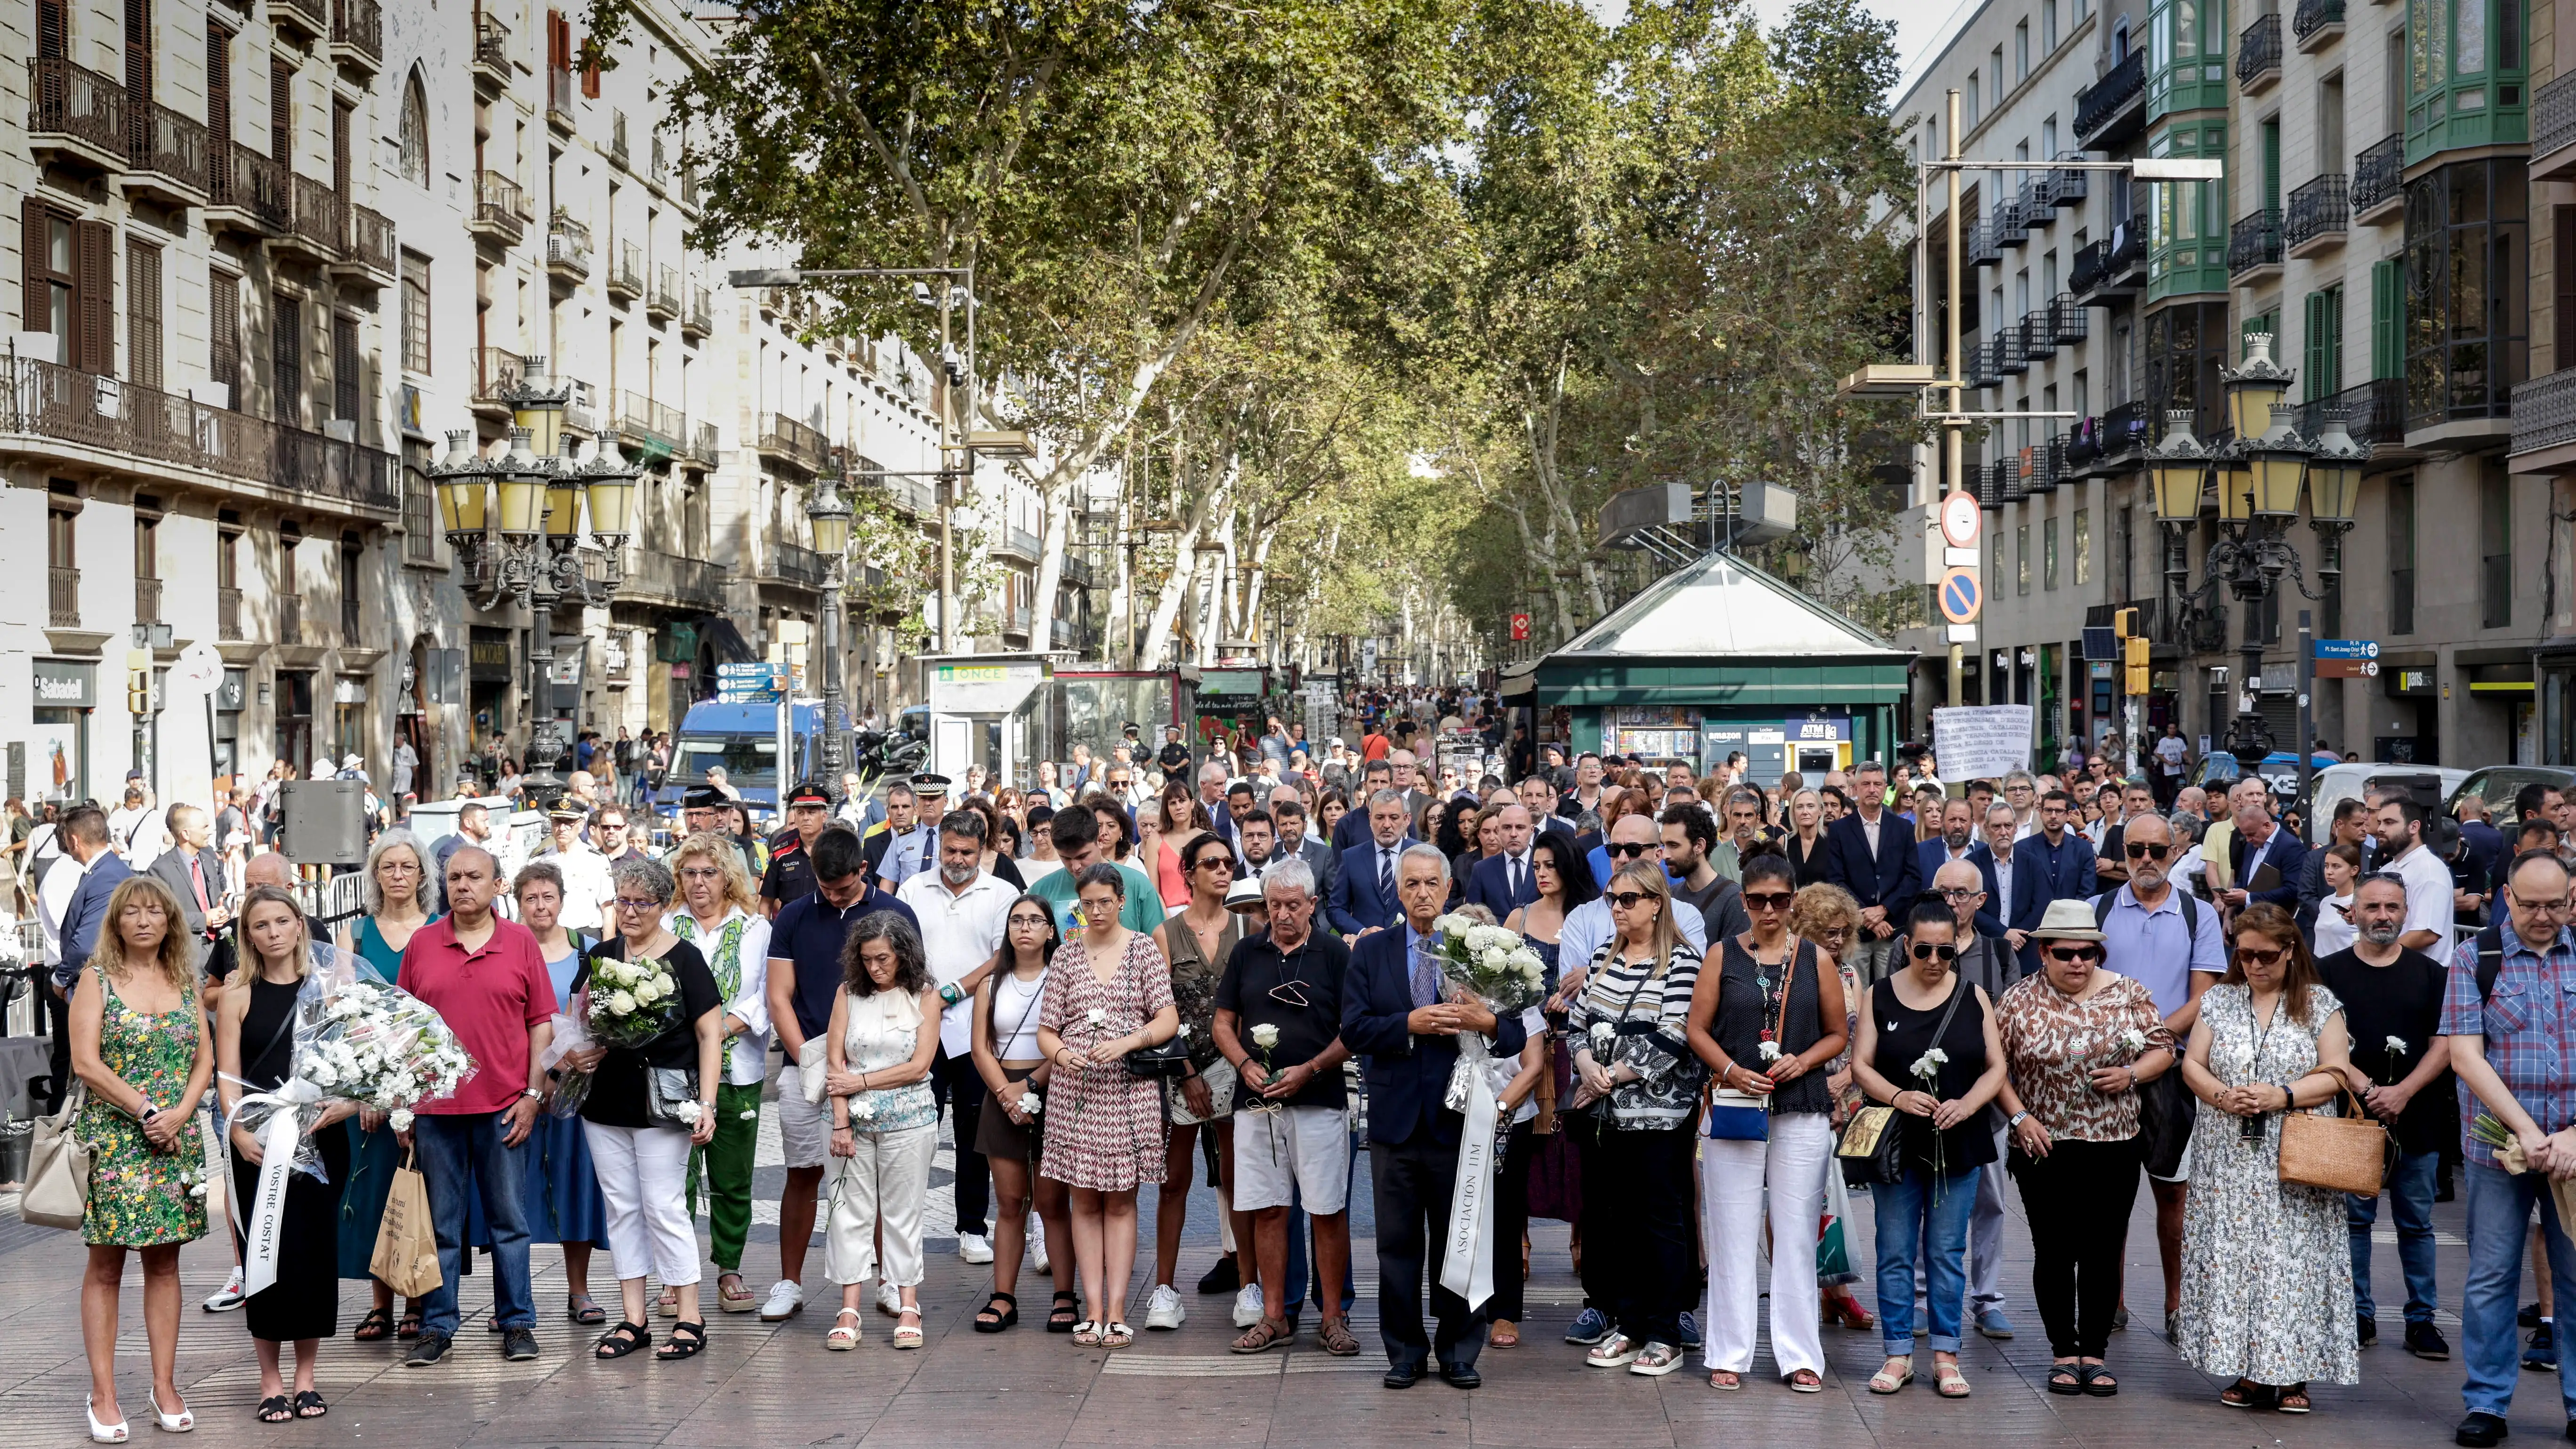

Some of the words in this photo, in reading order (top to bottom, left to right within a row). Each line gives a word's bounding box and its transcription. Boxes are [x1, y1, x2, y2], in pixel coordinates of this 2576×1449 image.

[960, 669, 1001, 678] ONCE
[2407, 672, 2422, 691] pans
[40, 677, 82, 699] Sabadell
[1801, 724, 1824, 733] ATM
[266, 1164, 282, 1209] VOSTRE
[1457, 1175, 1476, 1257] ASOCIACIÓN
[1469, 1143, 1481, 1167] 11M
[260, 1215, 274, 1261] COSTAT
